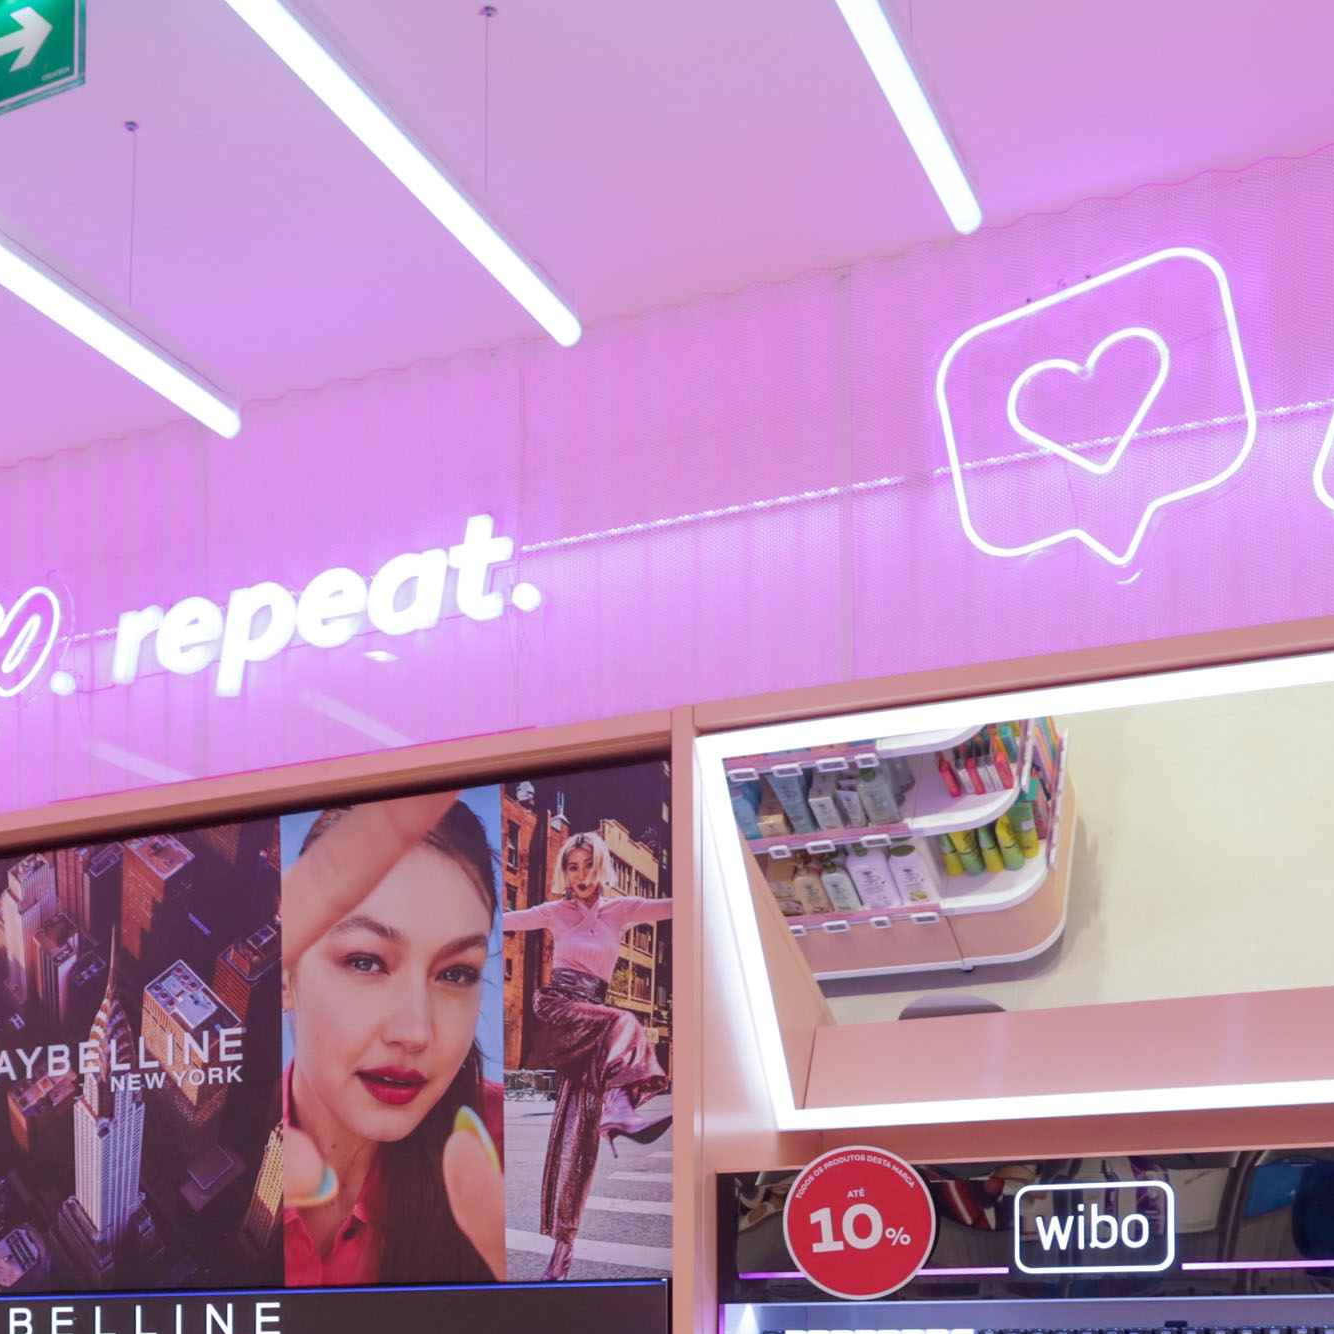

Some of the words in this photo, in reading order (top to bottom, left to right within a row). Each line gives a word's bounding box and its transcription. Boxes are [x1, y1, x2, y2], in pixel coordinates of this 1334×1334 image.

[112, 513, 542, 697] repeat.
[110, 1072, 167, 1093] NEW
[174, 1065, 244, 1089] YORK
[796, 1175, 814, 1199] TODOS
[823, 1154, 866, 1170] PRODUTOS
[867, 1155, 891, 1169] DESTA
[891, 1165, 915, 1188] MARCA
[847, 1188, 865, 1198] ATÉ
[809, 1203, 911, 1253] 10%
[1035, 1203, 1150, 1251] wibo
